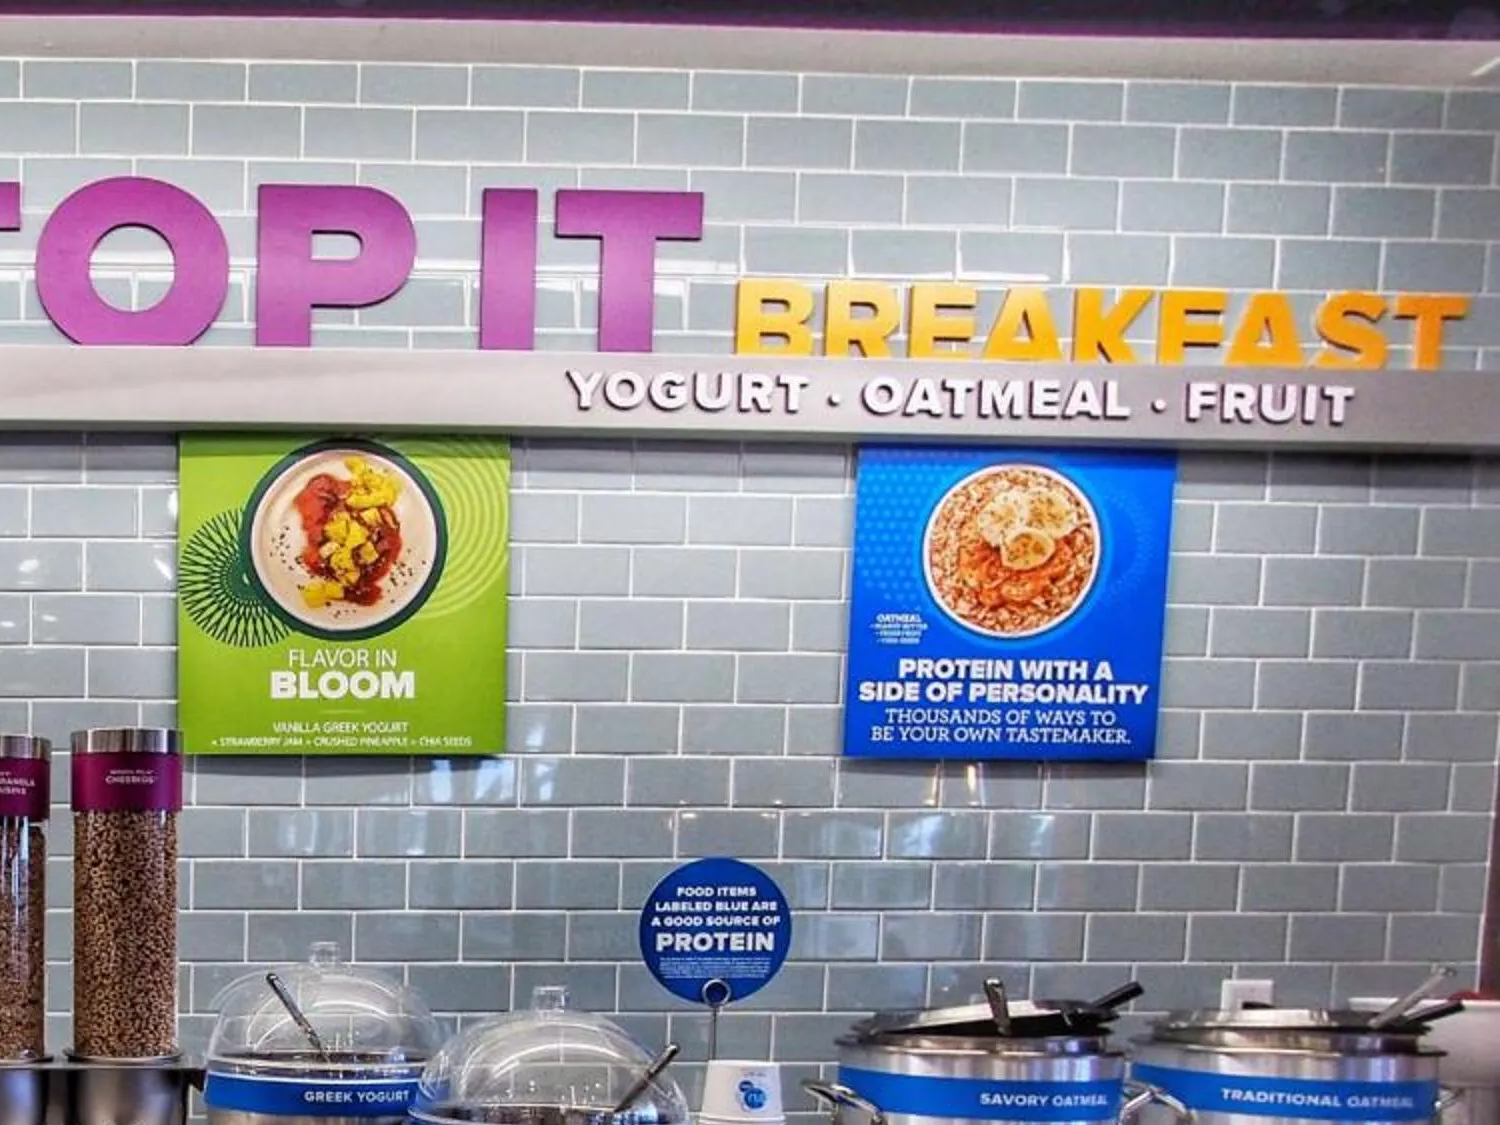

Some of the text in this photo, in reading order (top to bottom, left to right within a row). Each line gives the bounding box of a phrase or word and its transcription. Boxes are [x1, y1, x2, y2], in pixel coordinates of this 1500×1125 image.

[481, 187, 705, 352] IT
[735, 277, 1472, 371] BREAKFAST
[566, 370, 1355, 424] YOGURT OATMEAL FRUIT
[288, 649, 398, 667] FLAVOR IN
[899, 660, 1113, 681] PROTEIN WITH A
[270, 671, 414, 699] BLOOM
[859, 682, 1149, 704] SIDE OF PERSONALITY
[885, 708, 1116, 726] THOUSANDS OF WAYS TO
[273, 722, 409, 733] VANILLA GREEK YOGURT
[871, 727, 1132, 744] BE YOUR OWN TASTEMAKER.
[677, 887, 757, 897] FOOD ITEMS
[655, 901, 778, 912] LABELED BLUE ARE
[651, 916, 781, 927] A GOOD SOURCE OF
[656, 932, 775, 952] PROTEIN
[304, 1089, 409, 1103] GREEK YOGURT
[980, 1093, 1049, 1106] SAVORY
[1220, 1087, 1342, 1107] TRADITIONAL
